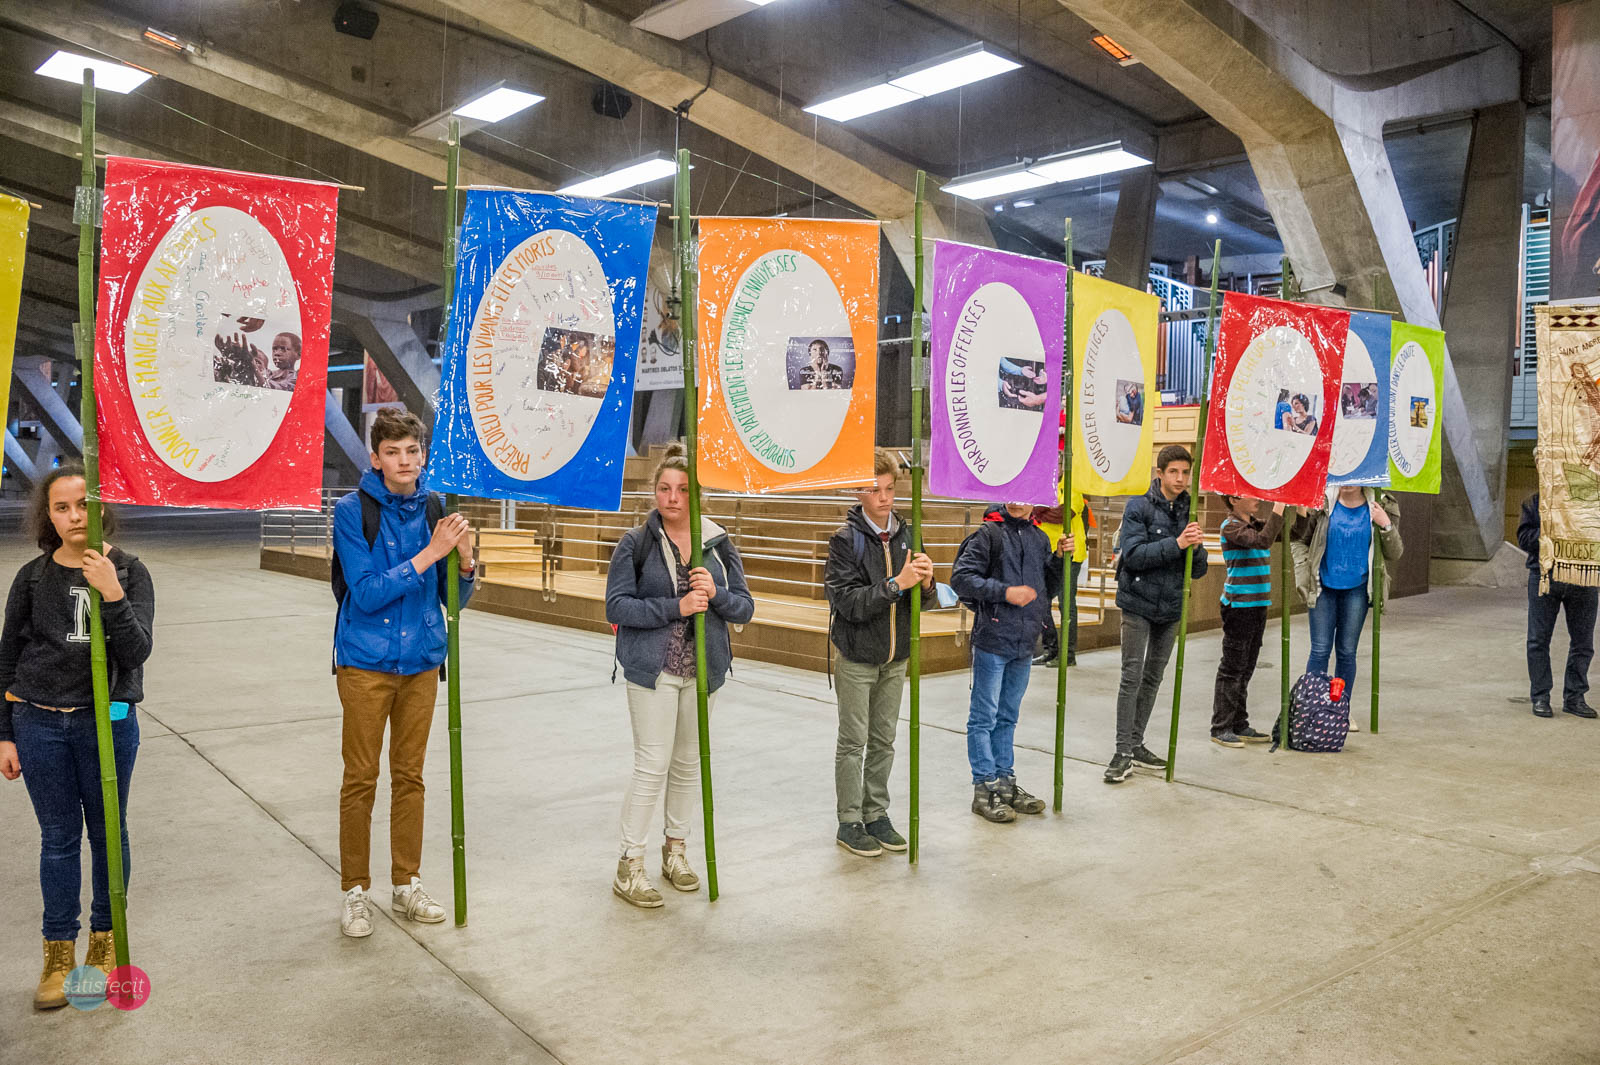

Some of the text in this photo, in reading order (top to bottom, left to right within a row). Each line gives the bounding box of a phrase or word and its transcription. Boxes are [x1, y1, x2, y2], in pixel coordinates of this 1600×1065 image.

[513, 235, 555, 271] MORTS
[498, 262, 522, 289] LES
[142, 279, 171, 313] AUX
[490, 284, 511, 303] ET
[472, 300, 504, 349] VIVANTS
[132, 312, 162, 386] MANGER
[472, 352, 492, 375] LES
[724, 351, 744, 372] LES
[1558, 346, 1579, 356] SAINT
[473, 379, 497, 412] POUR
[951, 298, 991, 474] PARDONNER LES OFFENSES
[1083, 319, 1111, 474] CONSOLER LES AFFLIGÉS
[1230, 396, 1244, 418] LES
[145, 404, 200, 469] DONNER
[479, 414, 505, 447] DIEU
[749, 428, 796, 468] SUPPORTER
[494, 438, 530, 475] PRIER
[1229, 423, 1257, 475] AVERTIR
